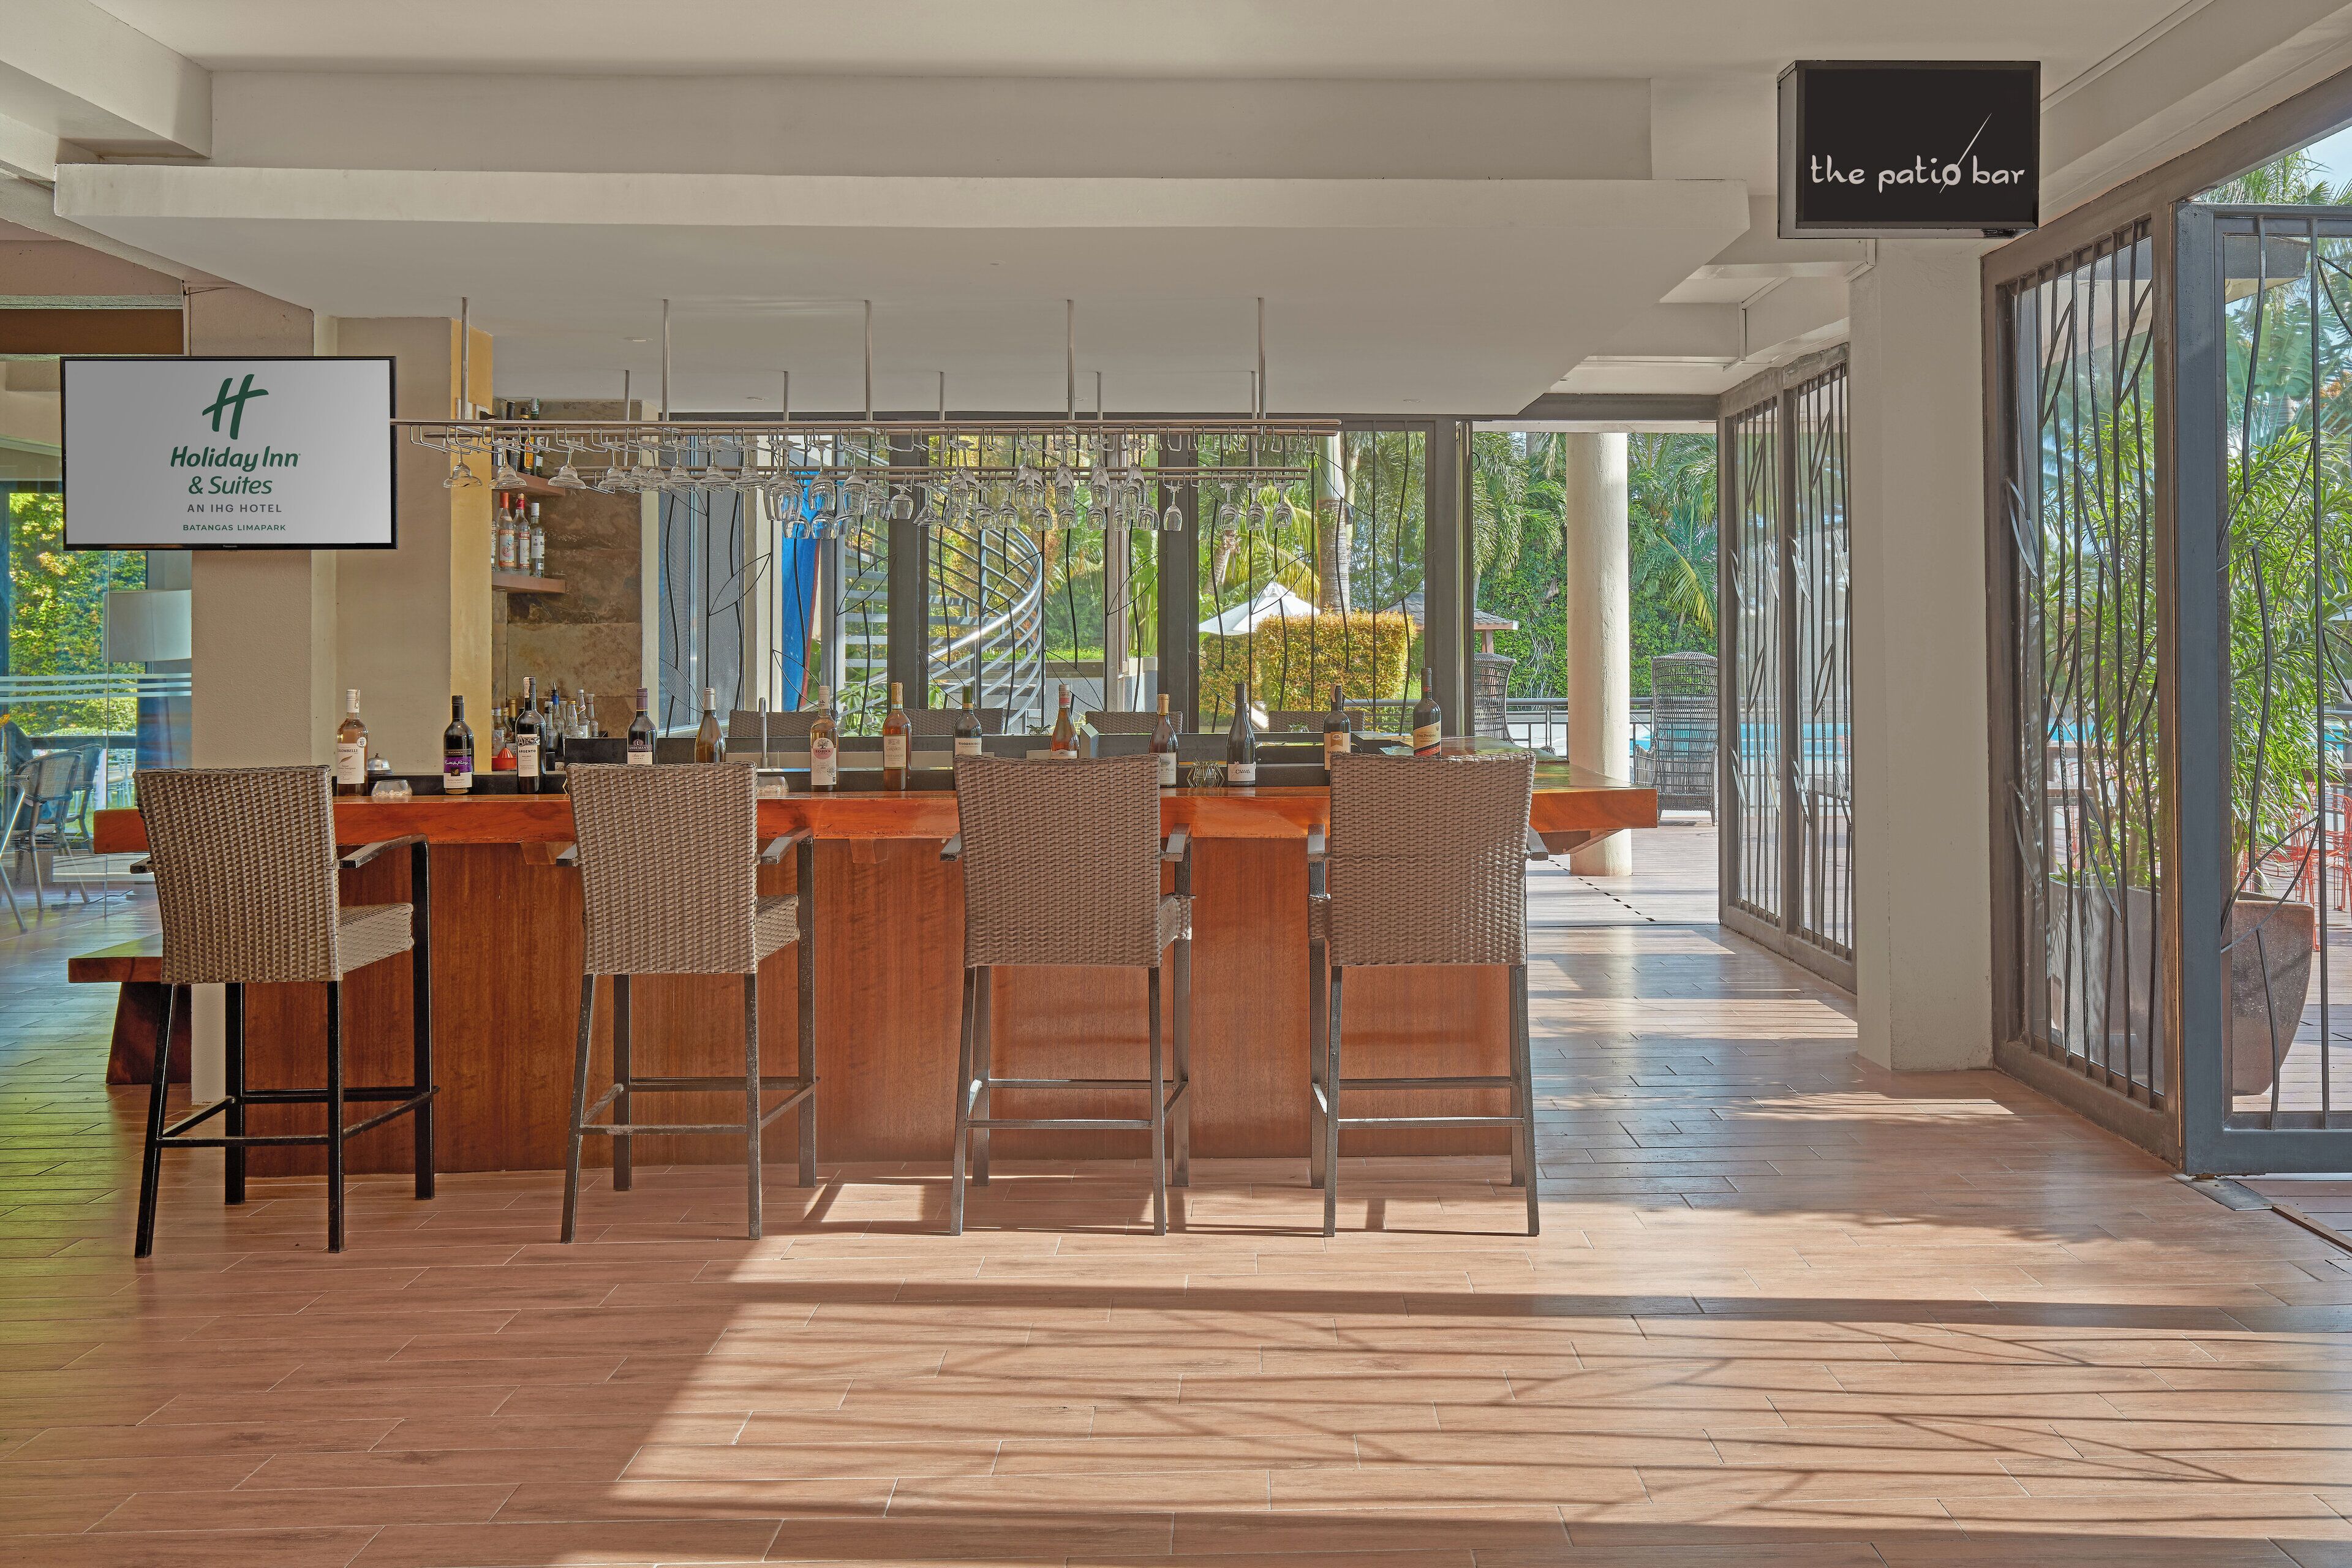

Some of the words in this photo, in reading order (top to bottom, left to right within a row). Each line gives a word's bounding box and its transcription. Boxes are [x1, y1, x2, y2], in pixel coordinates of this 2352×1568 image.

[1811, 154, 1865, 184] the
[1878, 154, 1962, 194] patio
[1972, 154, 2025, 184] bar
[170, 445, 258, 472] Holiday
[262, 445, 298, 467] Inn
[188, 475, 203, 494] &
[208, 475, 273, 494] Suites
[187, 504, 204, 513] AN
[211, 504, 234, 513] IHG
[239, 504, 282, 513] HOTEL
